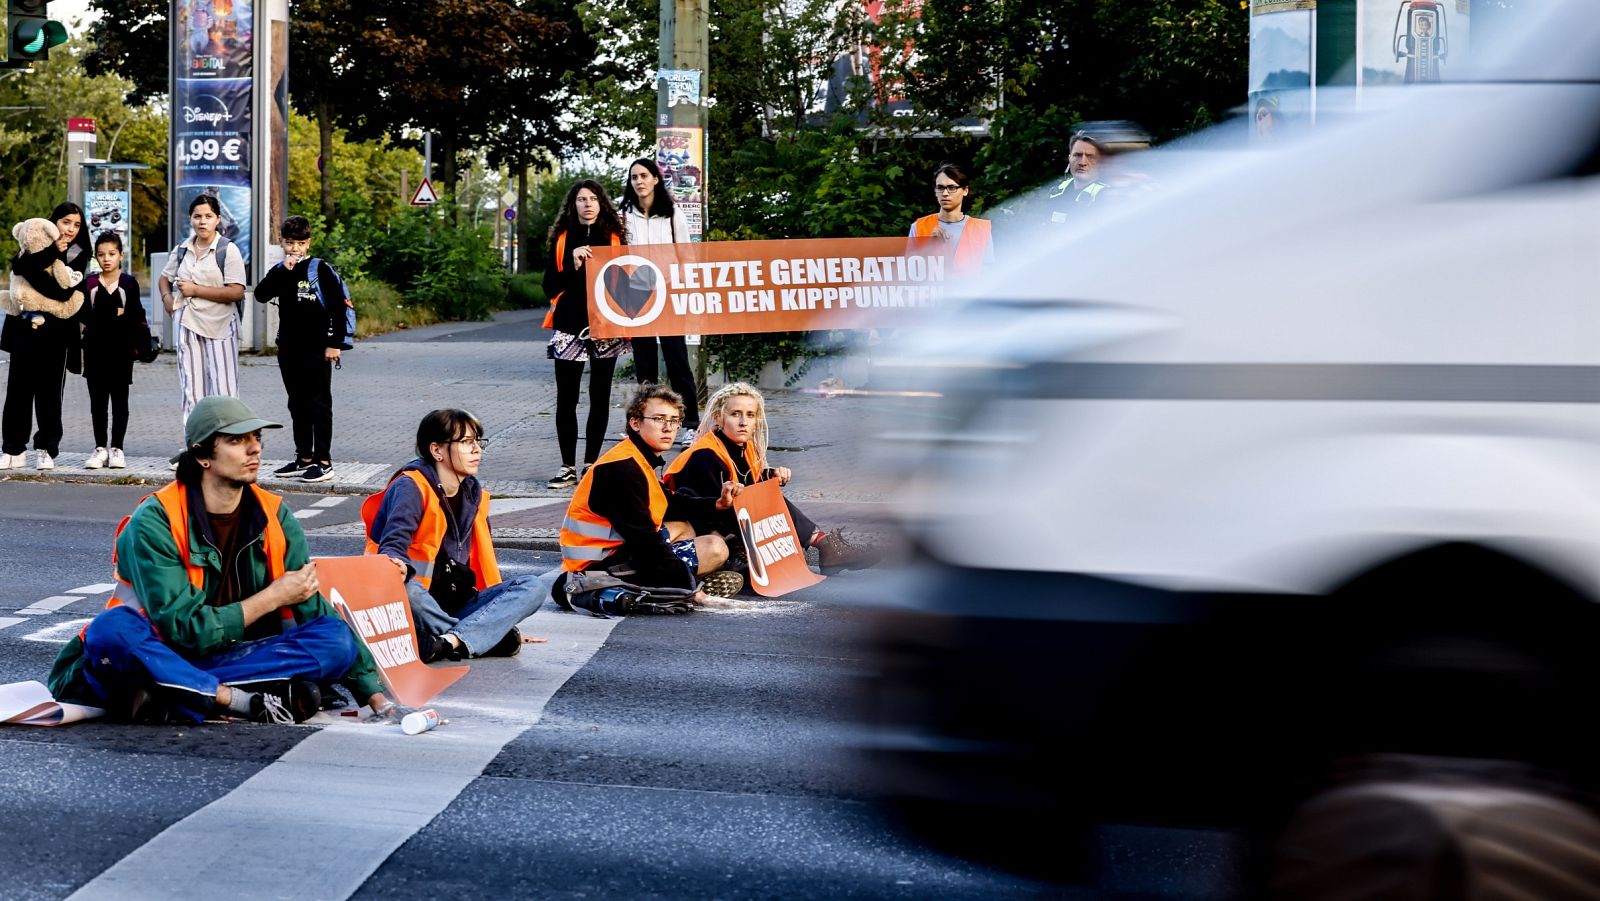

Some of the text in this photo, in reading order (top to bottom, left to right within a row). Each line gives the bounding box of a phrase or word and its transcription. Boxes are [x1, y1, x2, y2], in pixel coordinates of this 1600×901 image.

[176, 138, 241, 165] 1,99 €
[669, 255, 945, 289] LETZTE GENERATION
[670, 292, 723, 315] VOR
[728, 290, 777, 313] DEN
